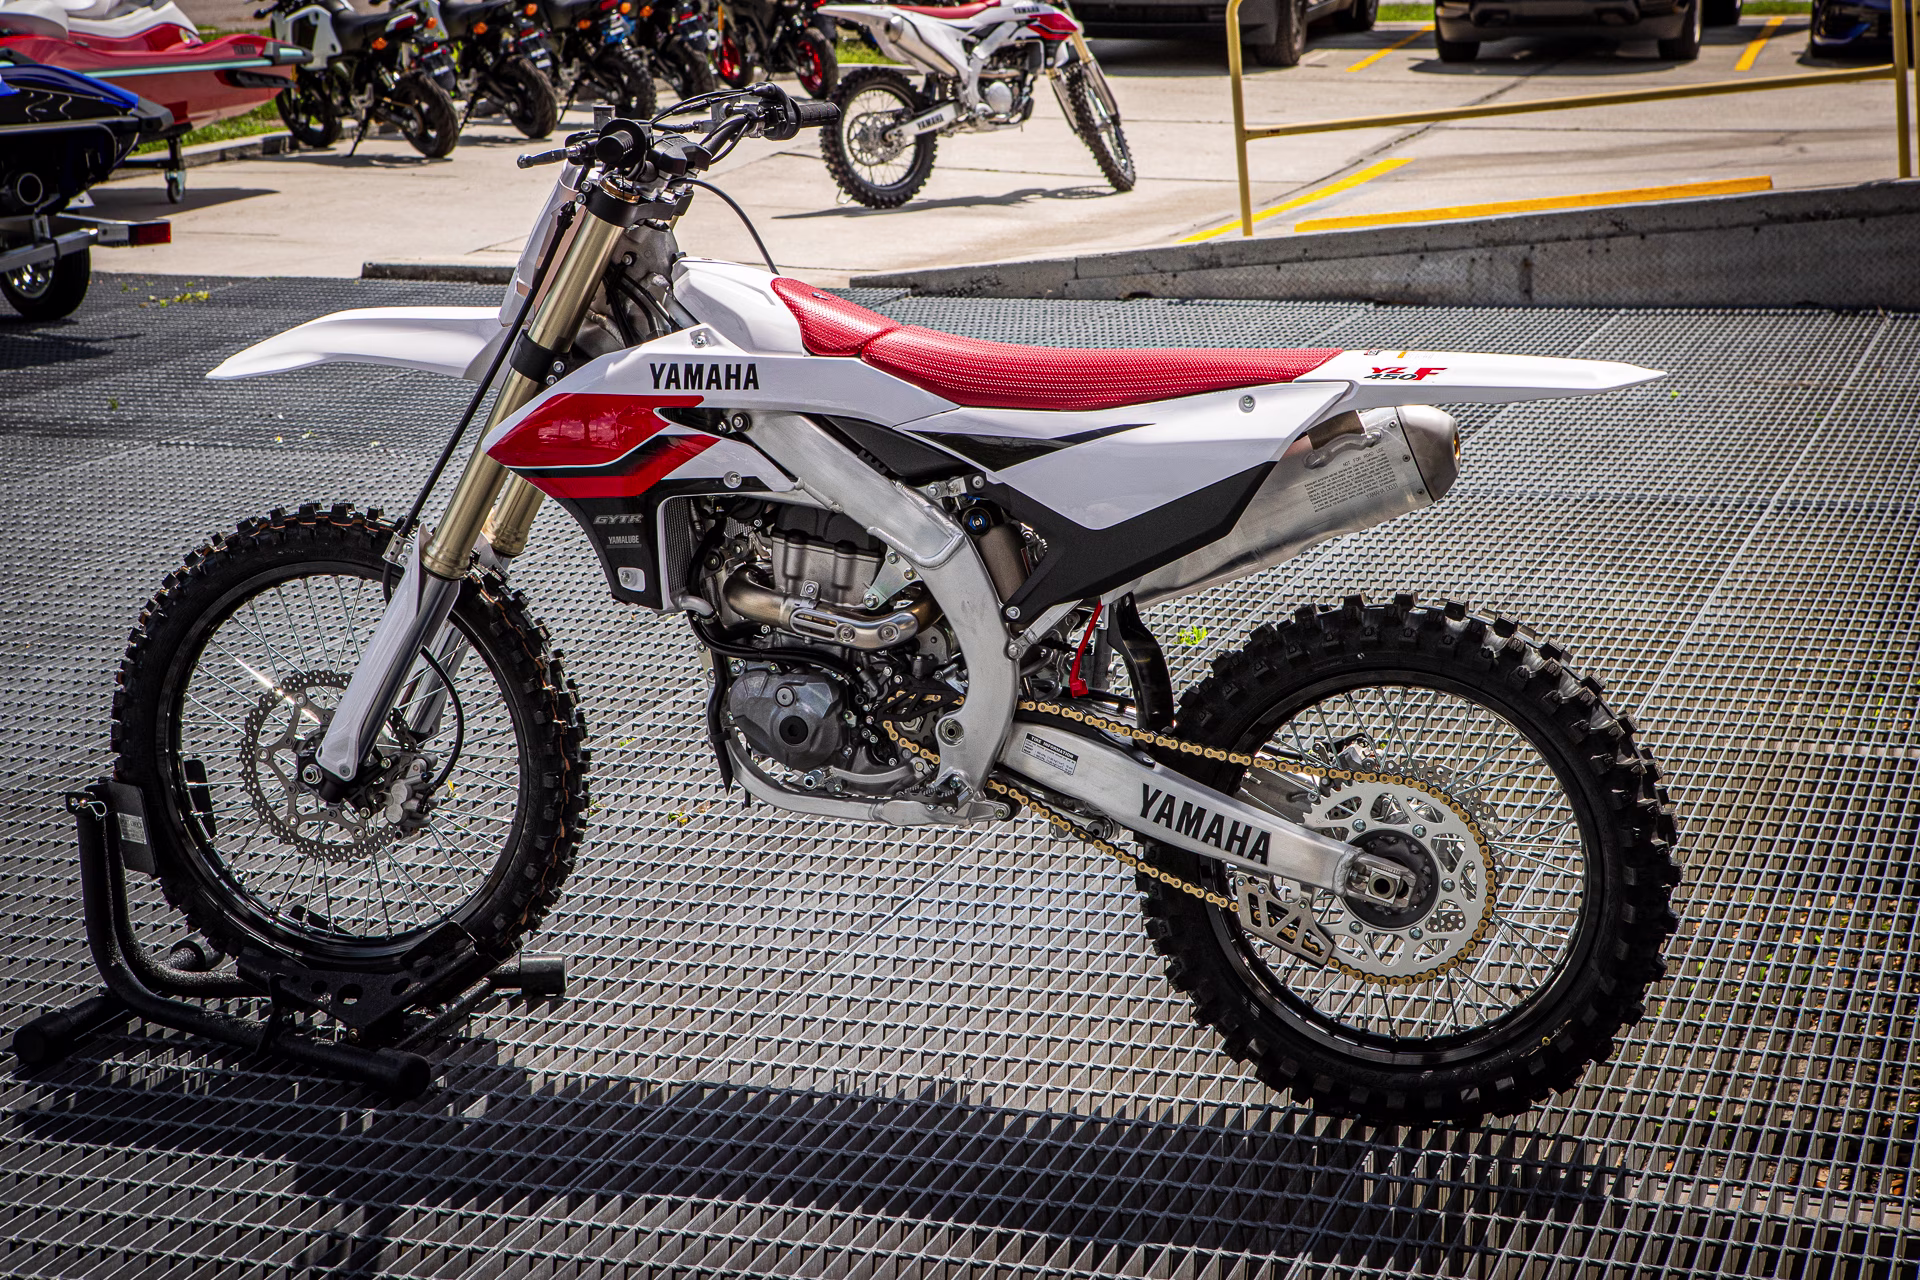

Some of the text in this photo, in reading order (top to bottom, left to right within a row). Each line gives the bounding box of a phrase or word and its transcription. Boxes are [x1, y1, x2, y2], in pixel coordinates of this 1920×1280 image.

[649, 363, 759, 390] YAMAHA
[593, 513, 644, 525] GYTR
[608, 535, 640, 544] YAMALUBE
[1140, 783, 1272, 866] YAMAHA
